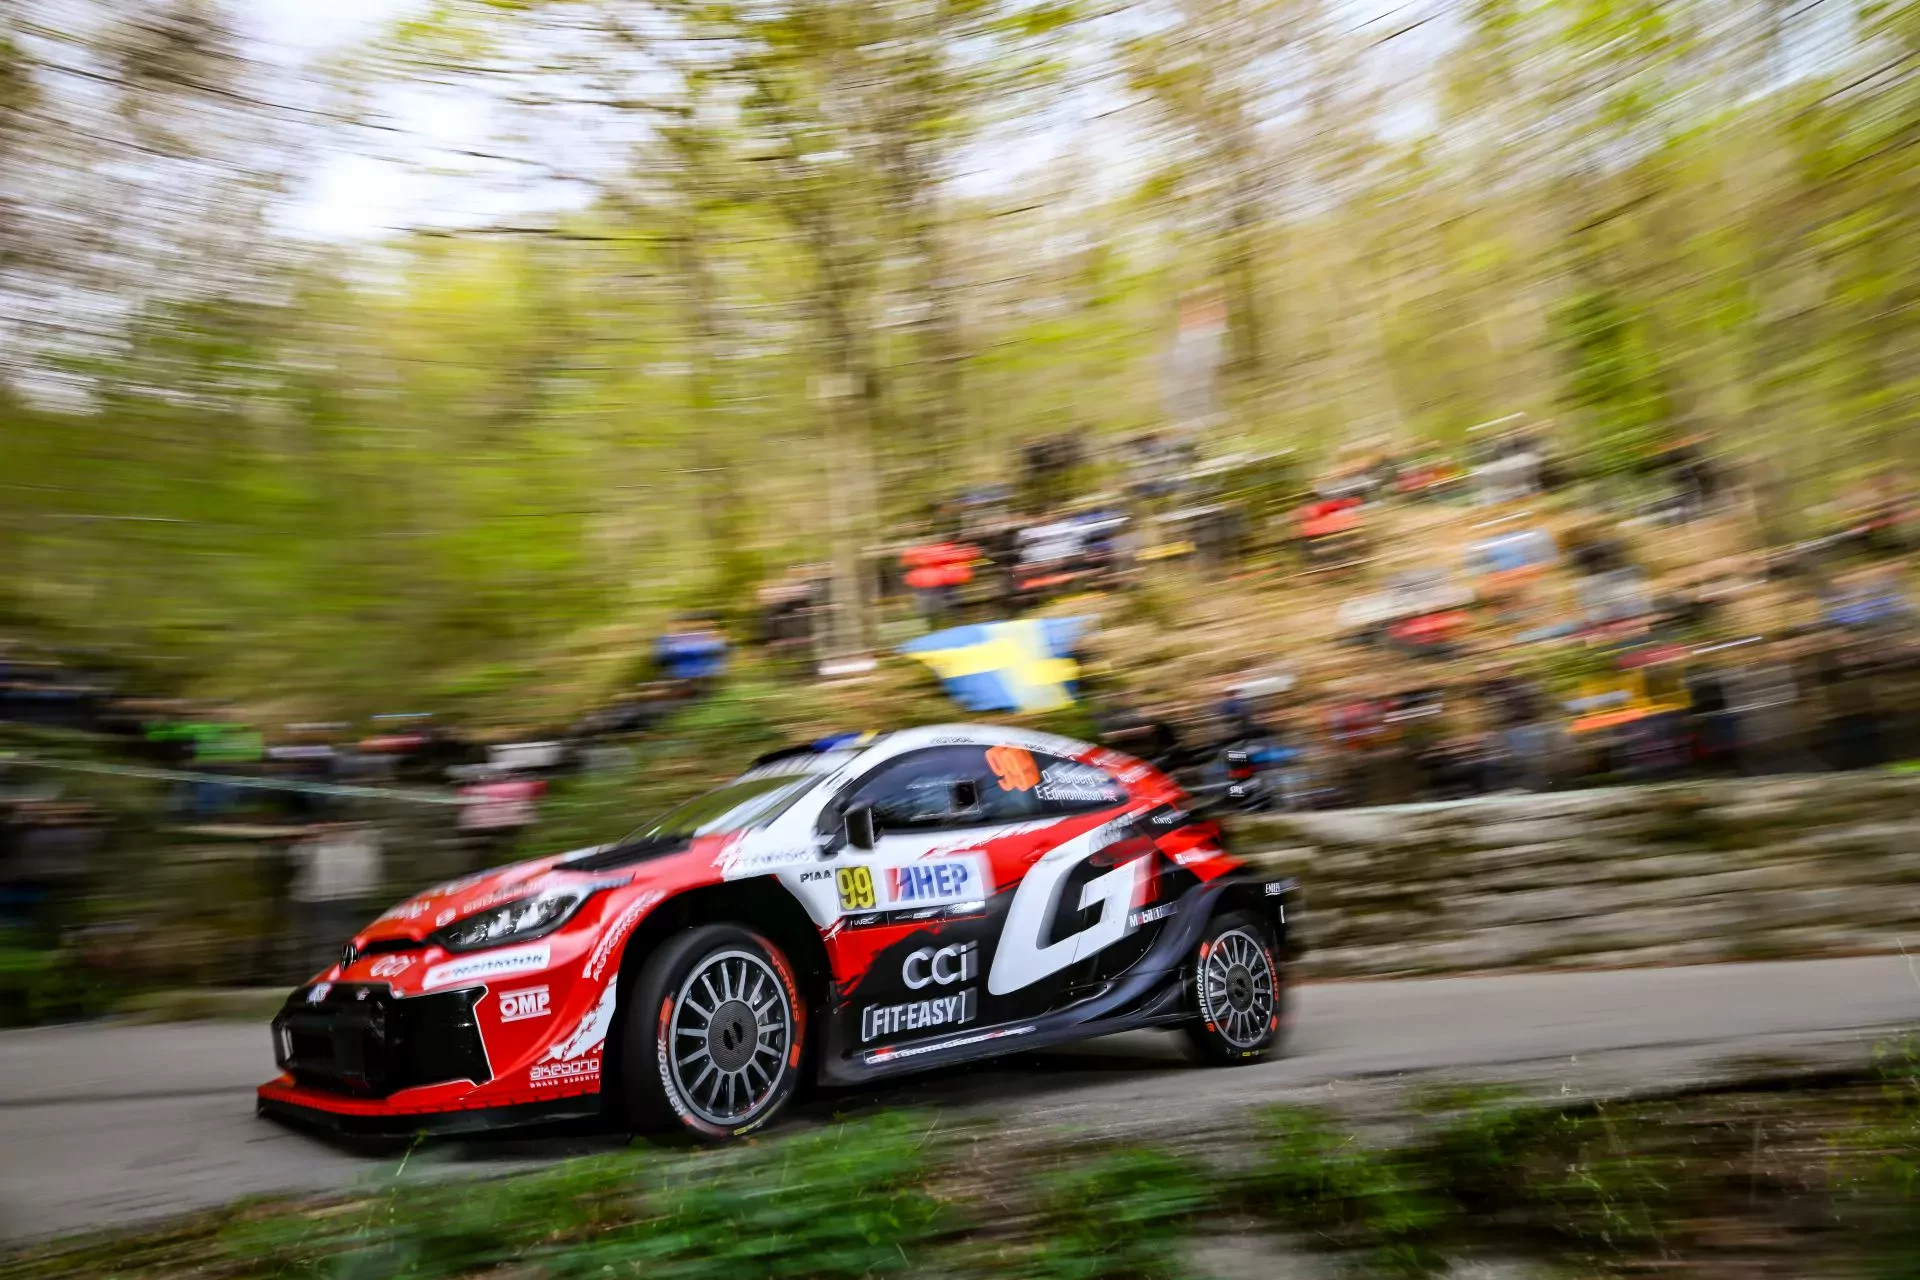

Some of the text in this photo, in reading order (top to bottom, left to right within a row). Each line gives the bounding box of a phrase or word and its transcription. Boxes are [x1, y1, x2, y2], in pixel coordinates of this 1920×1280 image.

[985, 746, 1040, 792] 99
[800, 869, 832, 884] PIAA
[836, 867, 875, 911] 99
[1128, 909, 1153, 928] Mobil
[499, 990, 551, 1018] OMP
